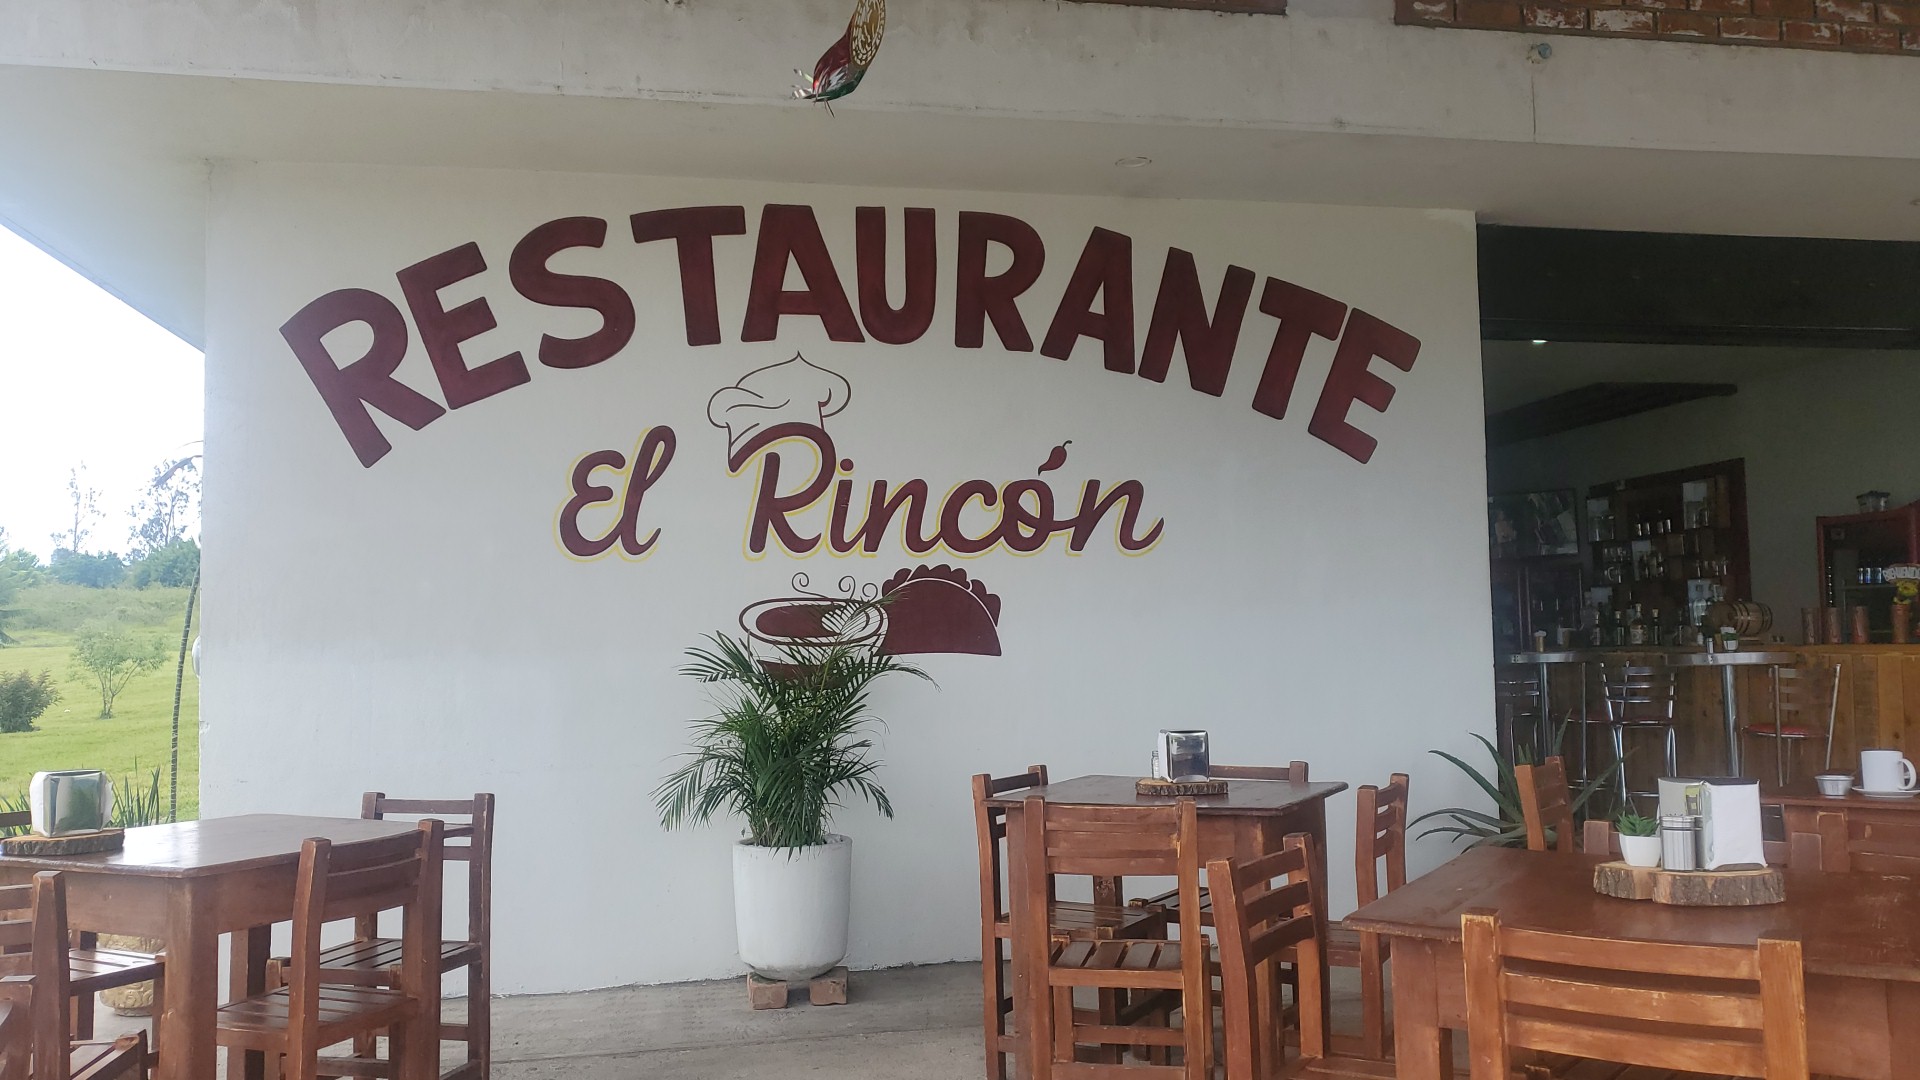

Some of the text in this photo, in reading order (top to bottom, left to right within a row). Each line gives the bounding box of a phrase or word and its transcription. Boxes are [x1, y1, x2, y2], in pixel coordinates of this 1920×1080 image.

[279, 203, 1421, 469] RESTAURANTE
[556, 420, 1165, 562] El Rincón
